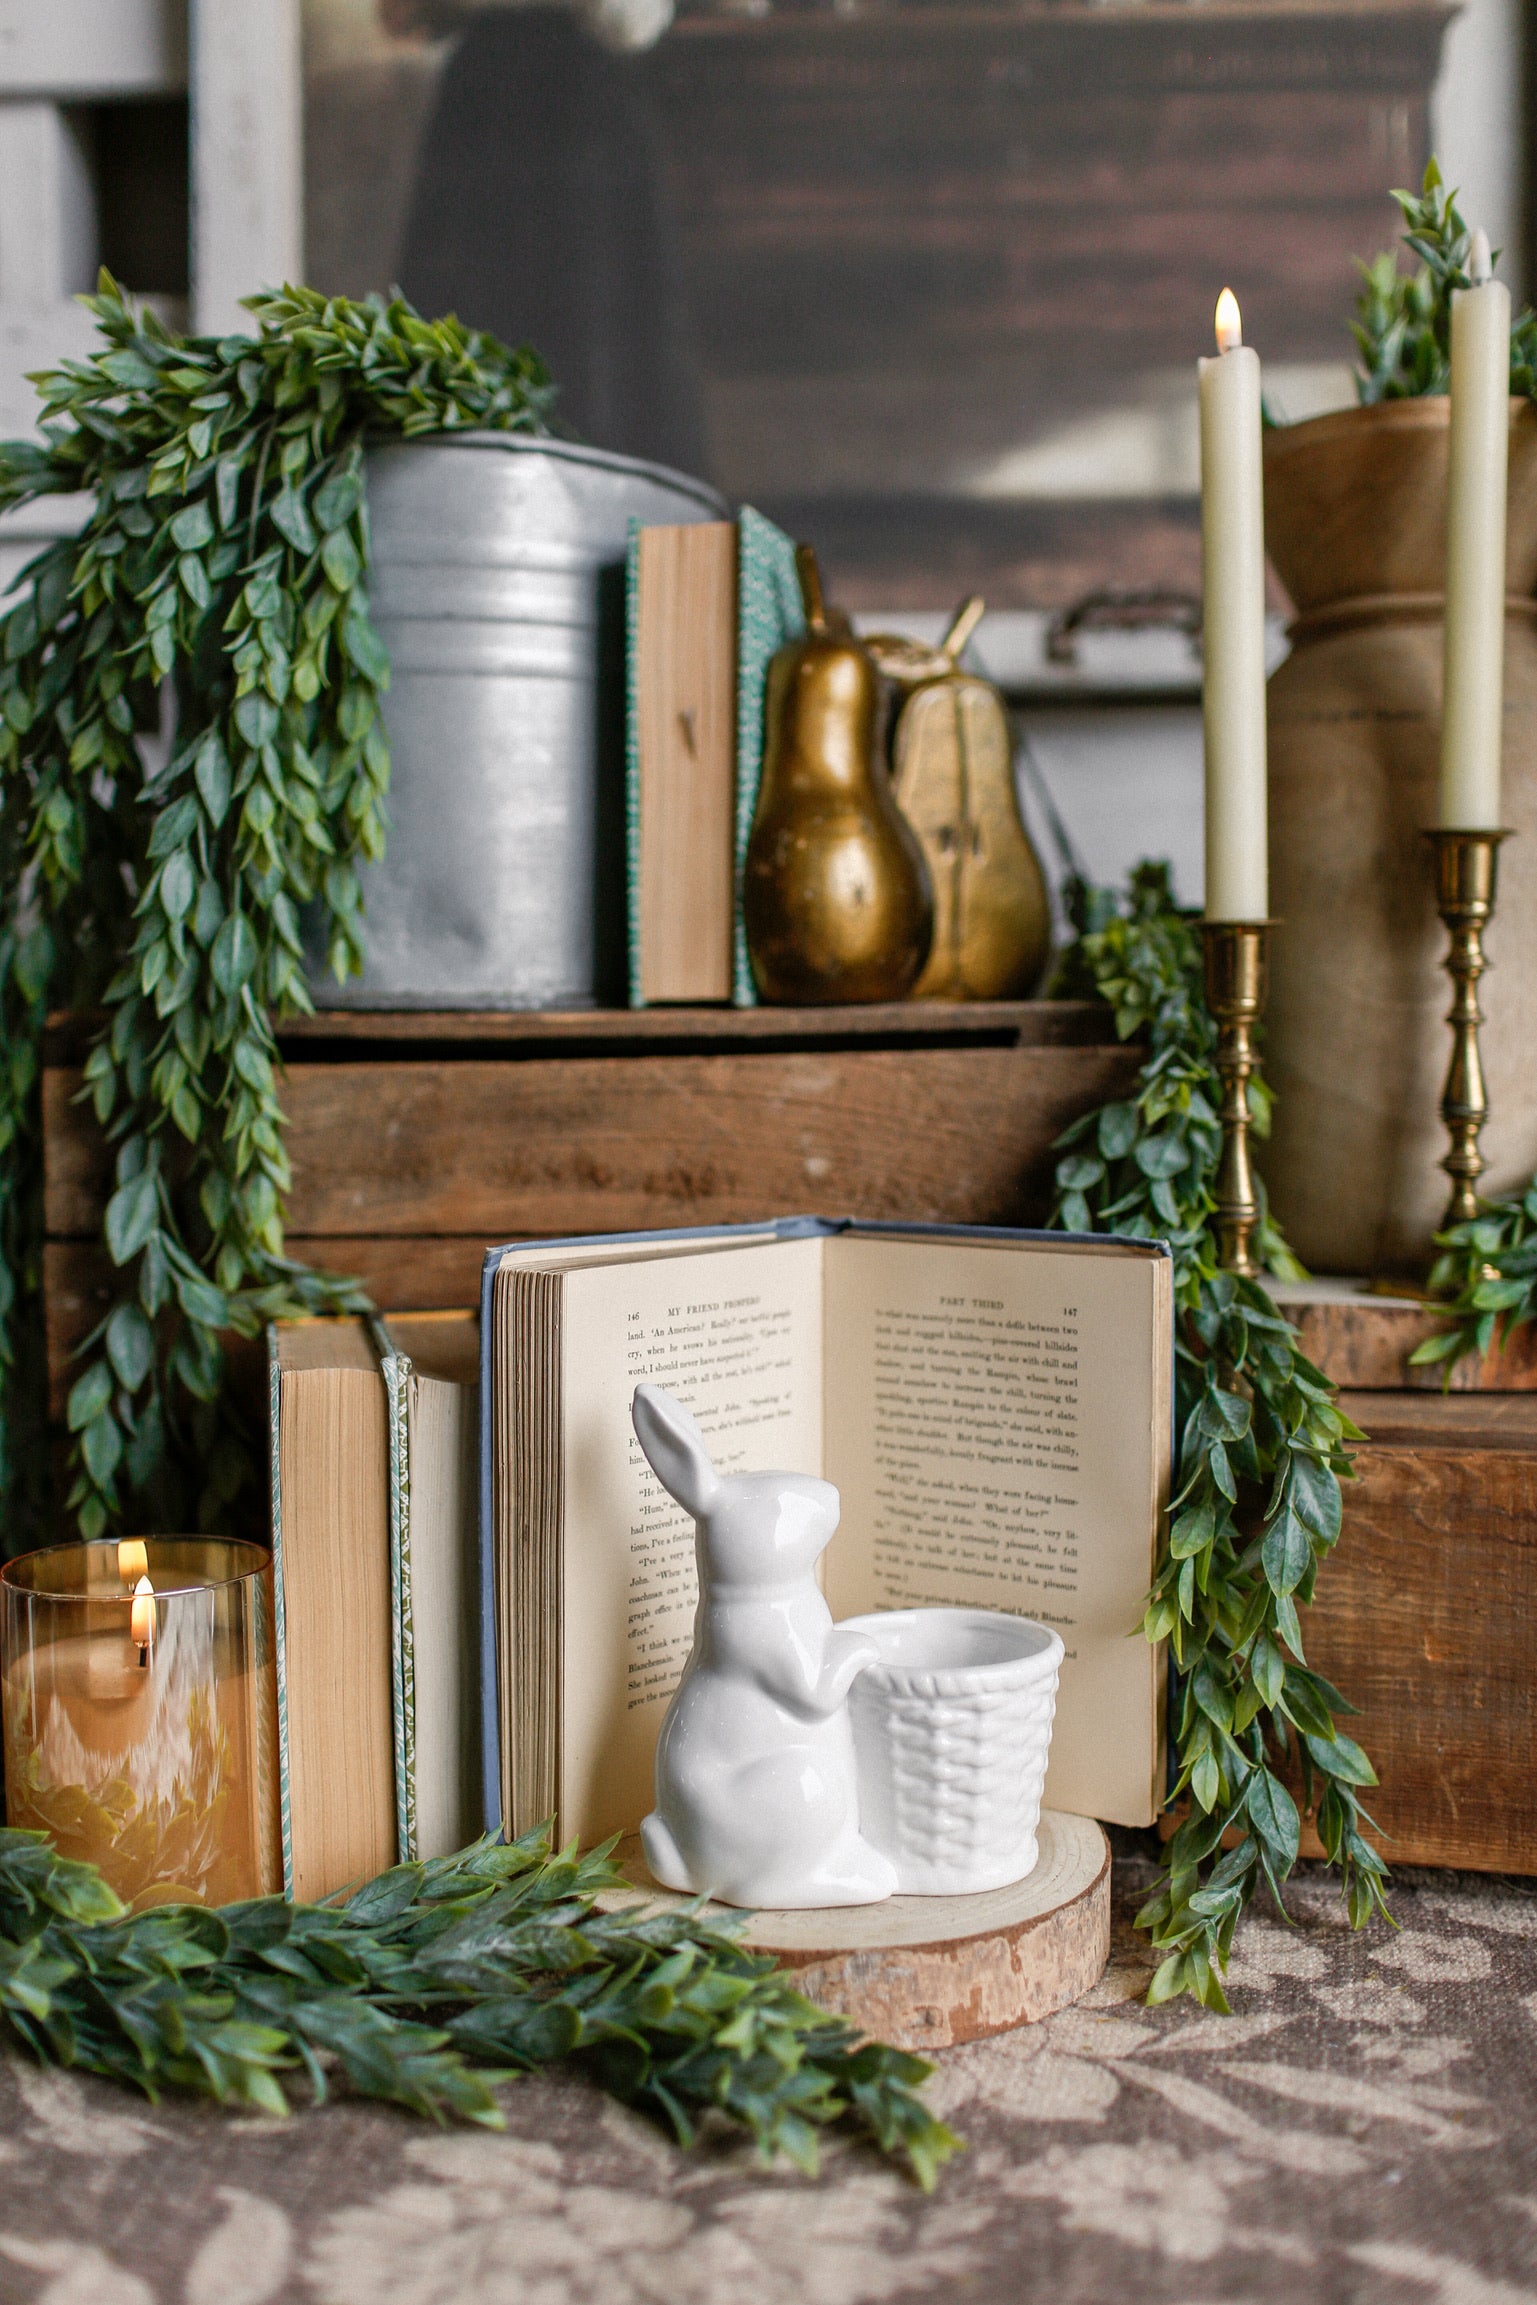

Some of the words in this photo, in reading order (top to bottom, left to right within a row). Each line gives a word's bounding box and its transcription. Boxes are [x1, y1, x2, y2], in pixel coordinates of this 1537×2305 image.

[627, 1311, 640, 1321] 146
[667, 1307, 681, 1317] MY
[687, 1303, 719, 1315] FRIEND
[1063, 1307, 1078, 1317] 147
[627, 1329, 646, 1341] land.
[1028, 1321, 1060, 1334] between
[1062, 1326, 1078, 1335] two
[627, 1351, 643, 1361] cry,
[647, 1345, 666, 1356] when
[669, 1343, 679, 1353] he
[1044, 1340, 1078, 1352] hillsides
[627, 1364, 648, 1376] word,
[655, 1360, 679, 1372] should
[679, 1360, 699, 1369] never
[1022, 1356, 1040, 1366] with
[1041, 1357, 1060, 1368] chill
[1061, 1360, 1078, 1370] and
[1054, 1375, 1078, 1388] brawl
[1029, 1391, 1062, 1404] turning
[1064, 1394, 1078, 1404] the
[1043, 1408, 1054, 1418] of
[1045, 1425, 1064, 1437] with
[1064, 1431, 1079, 1439] an-
[1052, 1444, 1080, 1458] chilly,
[1015, 1457, 1034, 1467] with
[1035, 1458, 1049, 1468] the
[1024, 1490, 1053, 1505] facing
[630, 1523, 644, 1536] had
[646, 1517, 673, 1532] received
[1043, 1529, 1062, 1541] very
[630, 1542, 650, 1553] tions,
[651, 1538, 665, 1548] I've
[1062, 1546, 1079, 1557] felt
[1058, 1563, 1078, 1574] time
[629, 1575, 651, 1588] John.
[628, 1608, 651, 1624] graph
[1017, 1607, 1039, 1622] Lady
